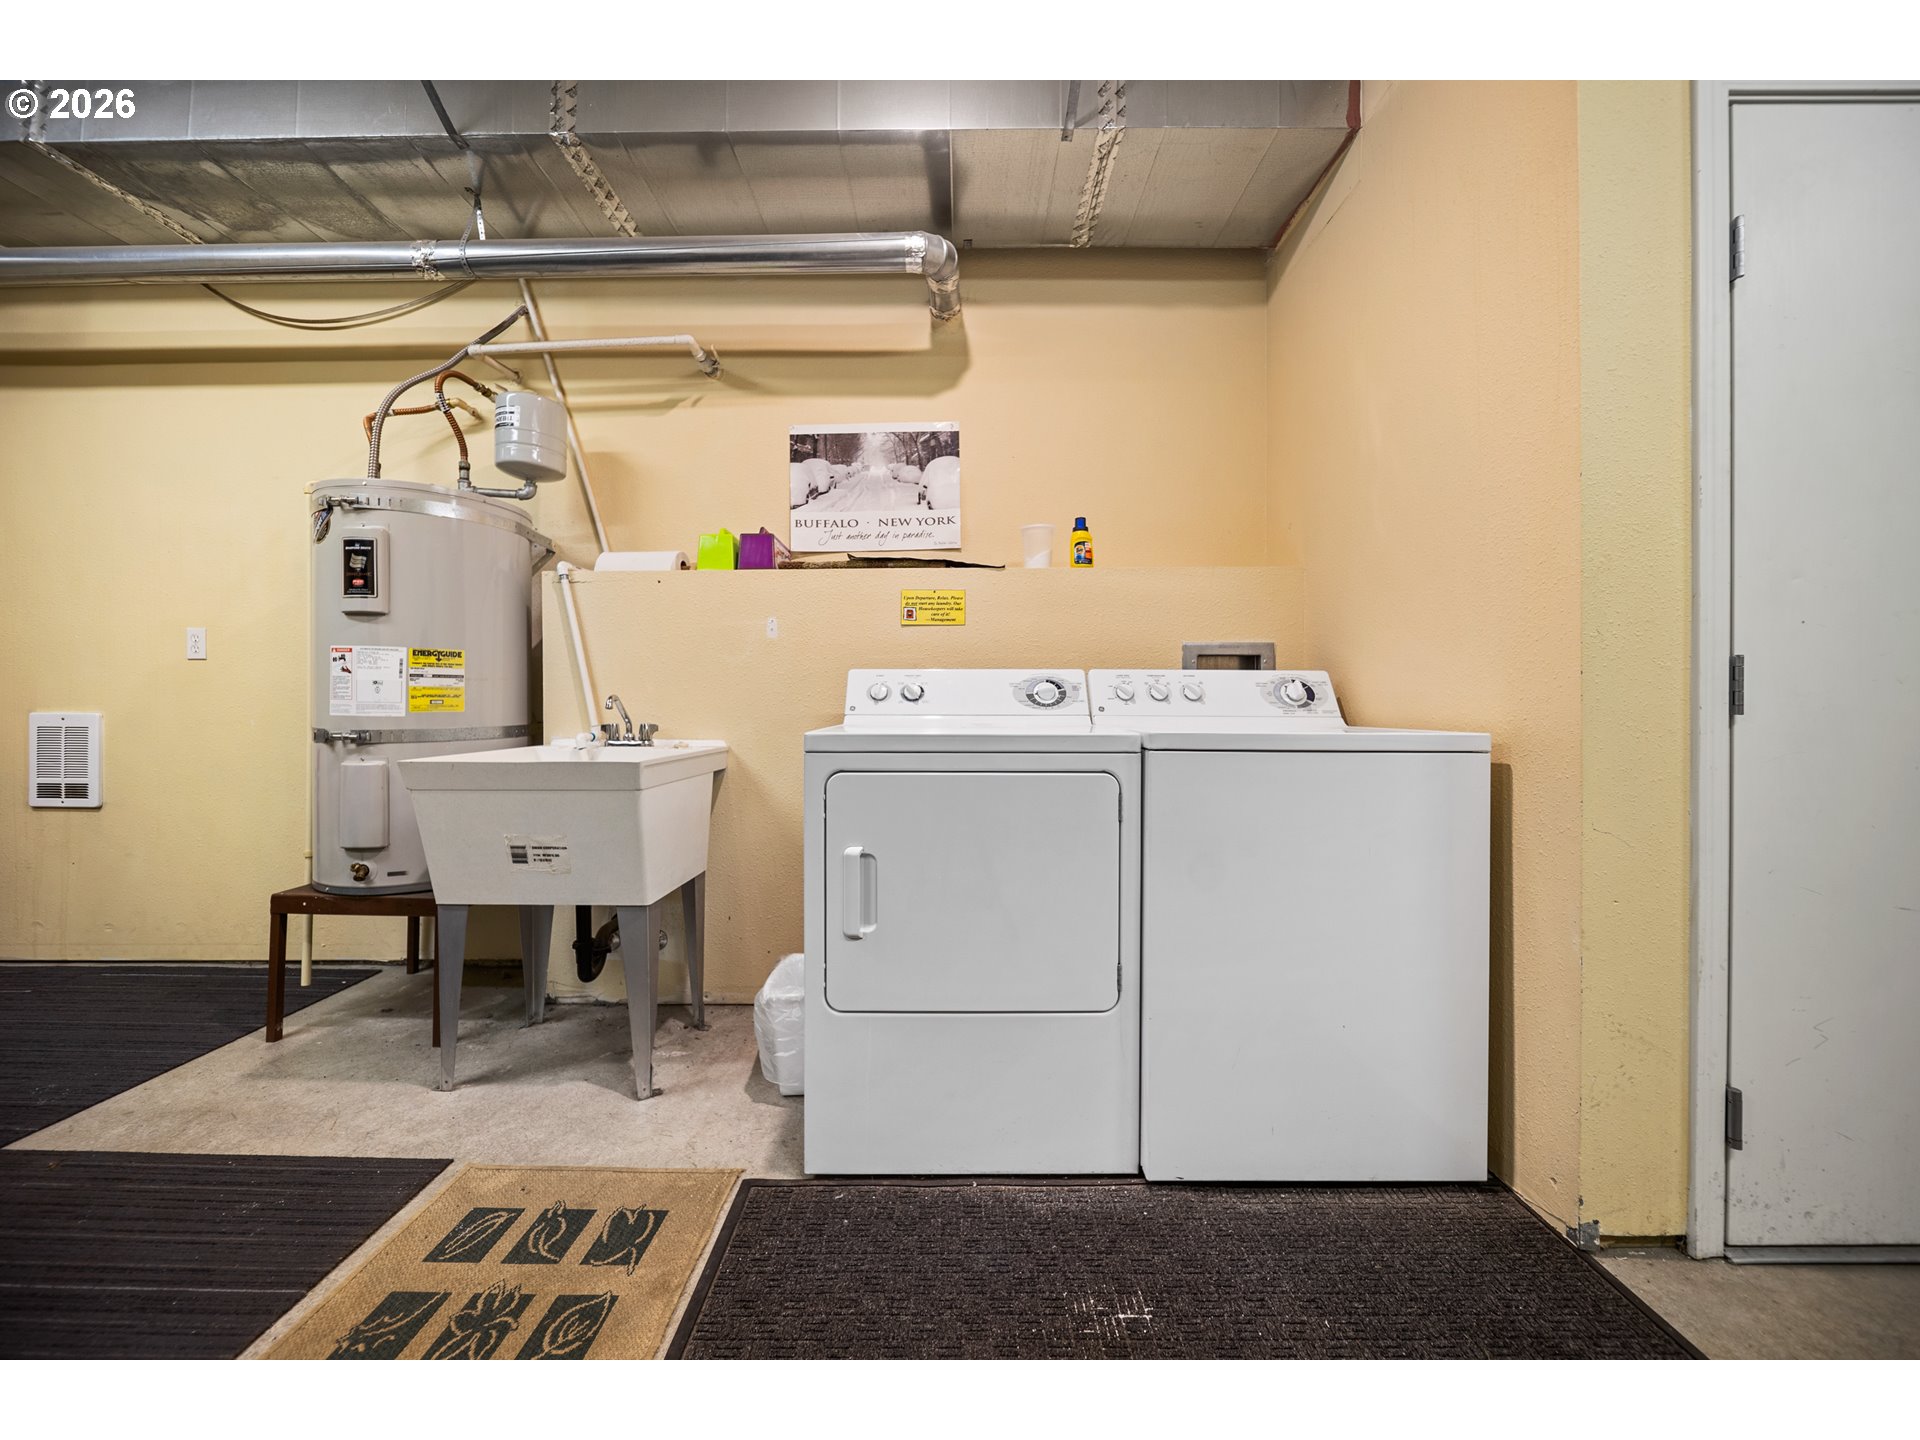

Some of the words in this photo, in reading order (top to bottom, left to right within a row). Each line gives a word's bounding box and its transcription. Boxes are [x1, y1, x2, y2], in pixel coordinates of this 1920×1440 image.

[794, 518, 859, 529] BUFFALO
[878, 517, 912, 527] NEW
[915, 515, 957, 527] YORK
[817, 529, 843, 546] Just
[845, 531, 872, 541] another
[874, 530, 891, 547] day
[901, 530, 935, 541] paradise.
[412, 649, 462, 659] ENERGYGUIDE
